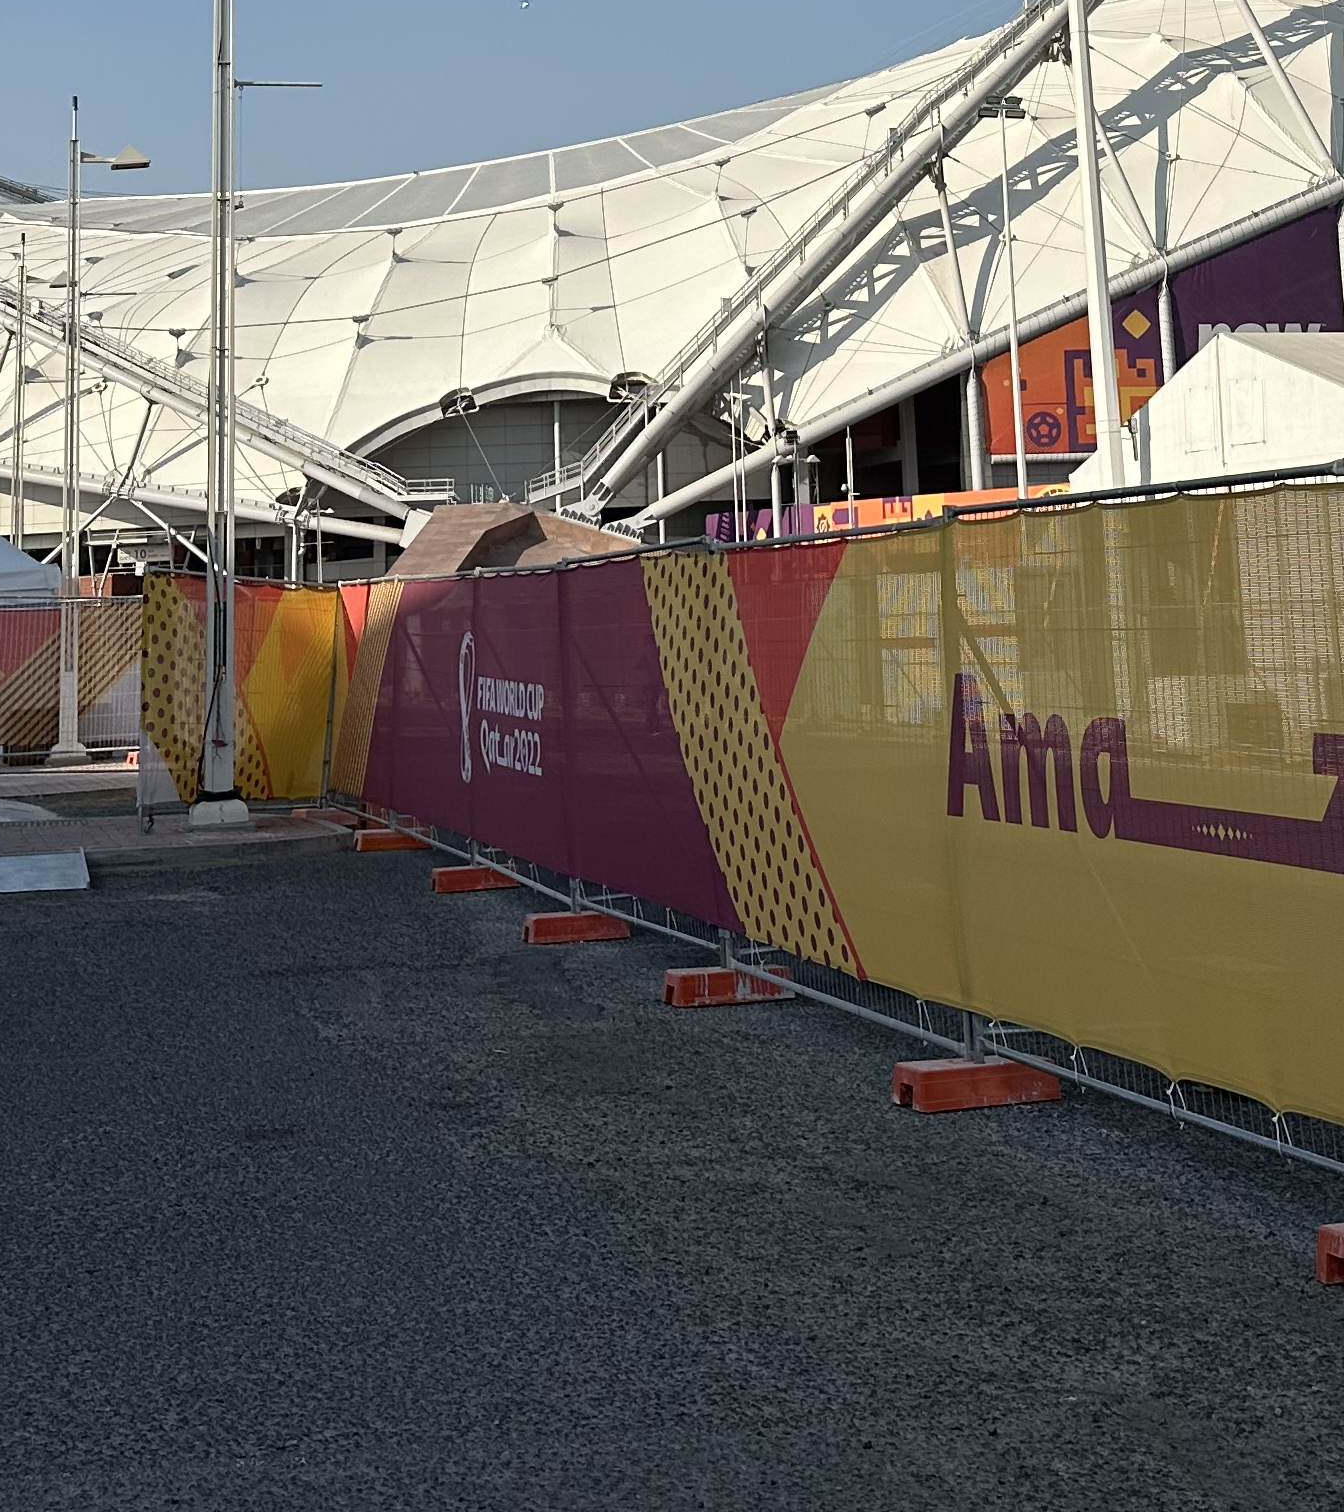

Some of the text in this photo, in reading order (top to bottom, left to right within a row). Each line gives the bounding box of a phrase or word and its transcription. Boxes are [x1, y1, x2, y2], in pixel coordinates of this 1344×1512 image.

[134, 549, 147, 559] 10
[477, 676, 545, 721] FIFA WORLD CUP
